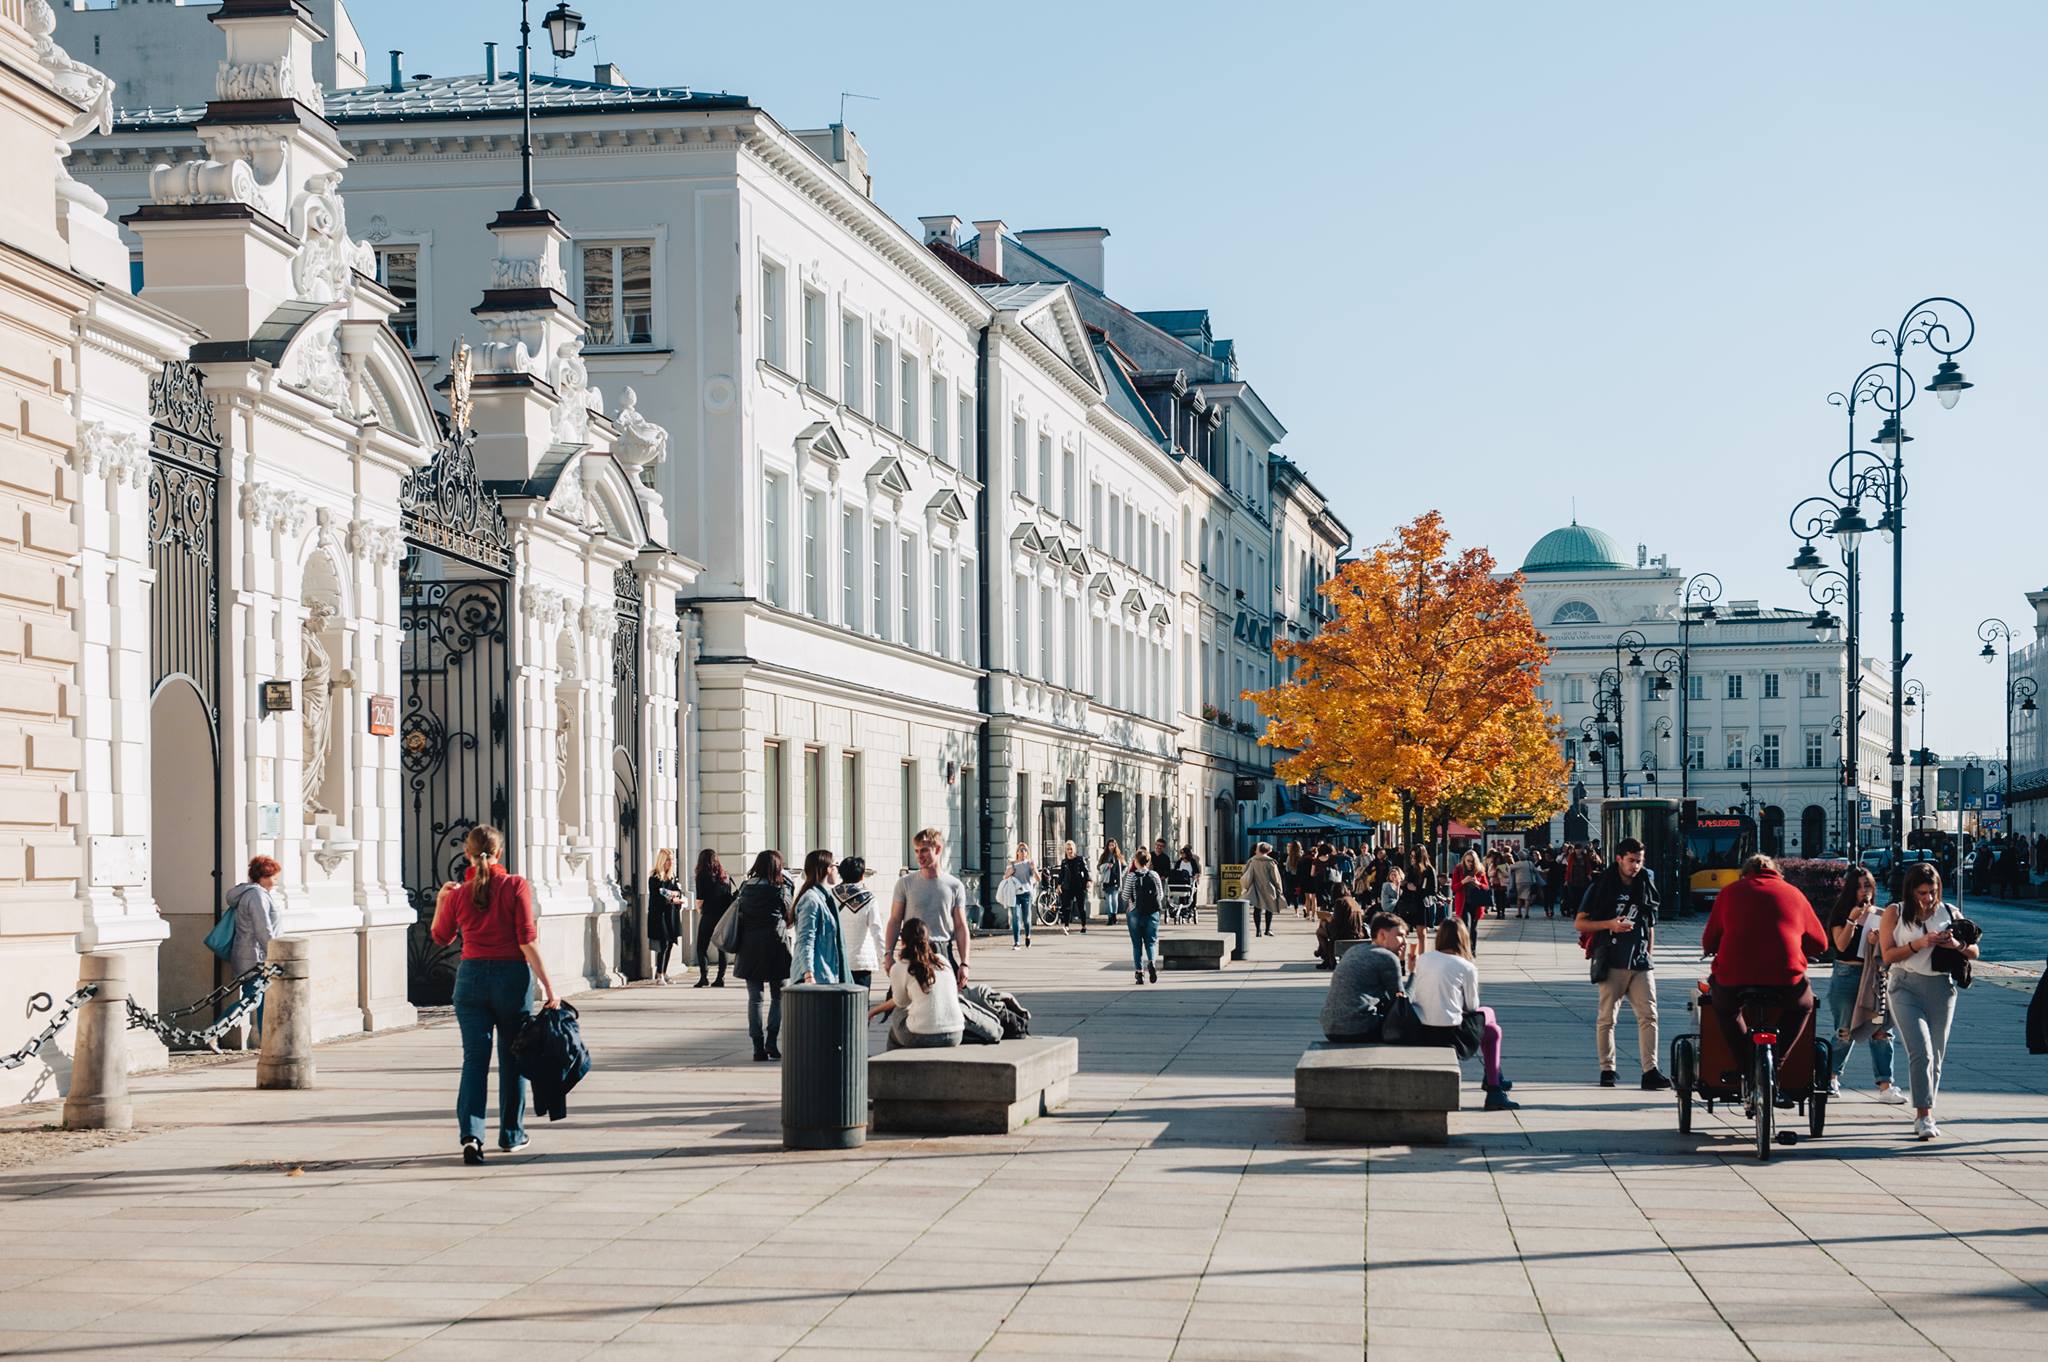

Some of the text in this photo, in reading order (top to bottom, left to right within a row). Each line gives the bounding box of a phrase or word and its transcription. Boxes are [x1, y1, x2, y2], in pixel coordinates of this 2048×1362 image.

[1861, 801, 1869, 810] P
[1985, 793, 1997, 808] P
[1228, 886, 1236, 897] 5
